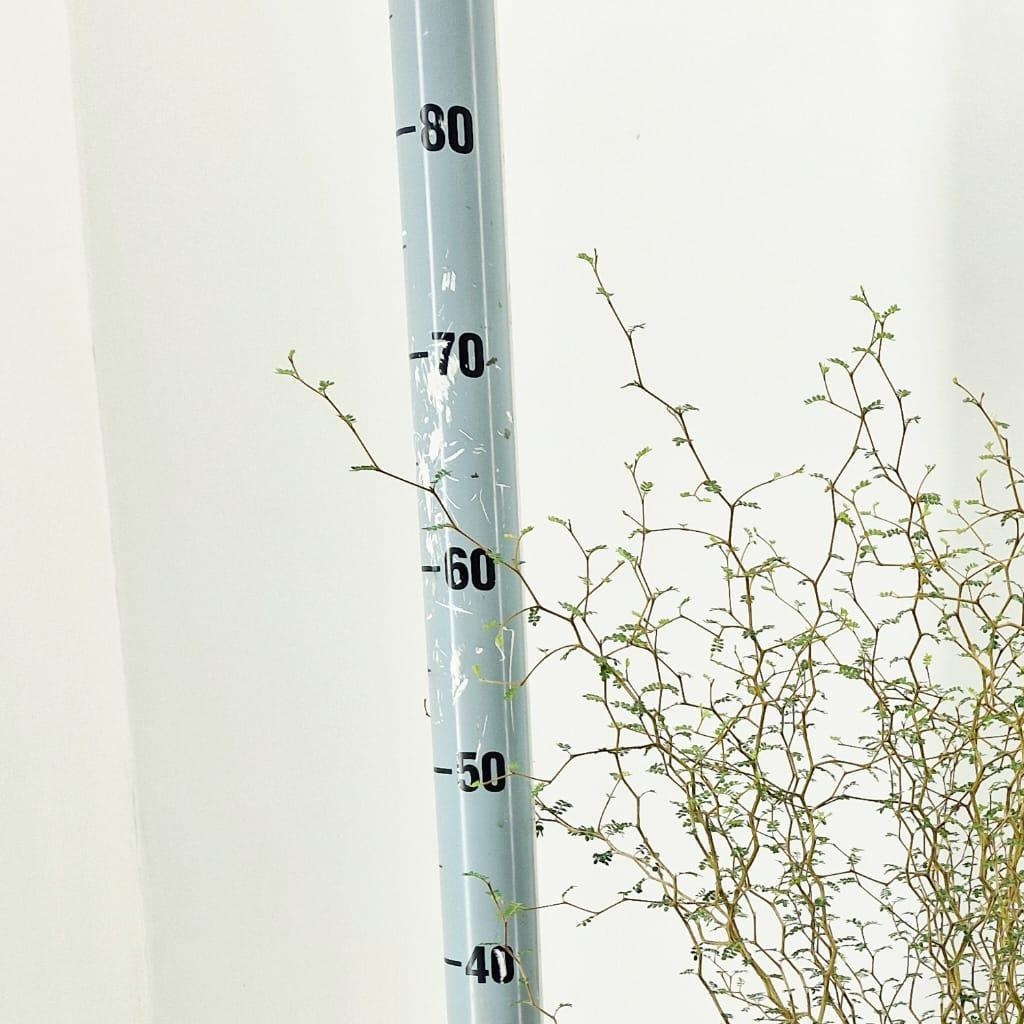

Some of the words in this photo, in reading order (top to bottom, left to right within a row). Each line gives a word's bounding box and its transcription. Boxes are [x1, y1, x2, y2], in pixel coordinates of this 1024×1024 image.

[421, 103, 474, 154] 80
[432, 332, 485, 378] 70
[444, 547, 496, 591] 60
[456, 751, 506, 792] 50
[465, 945, 515, 984] 40
